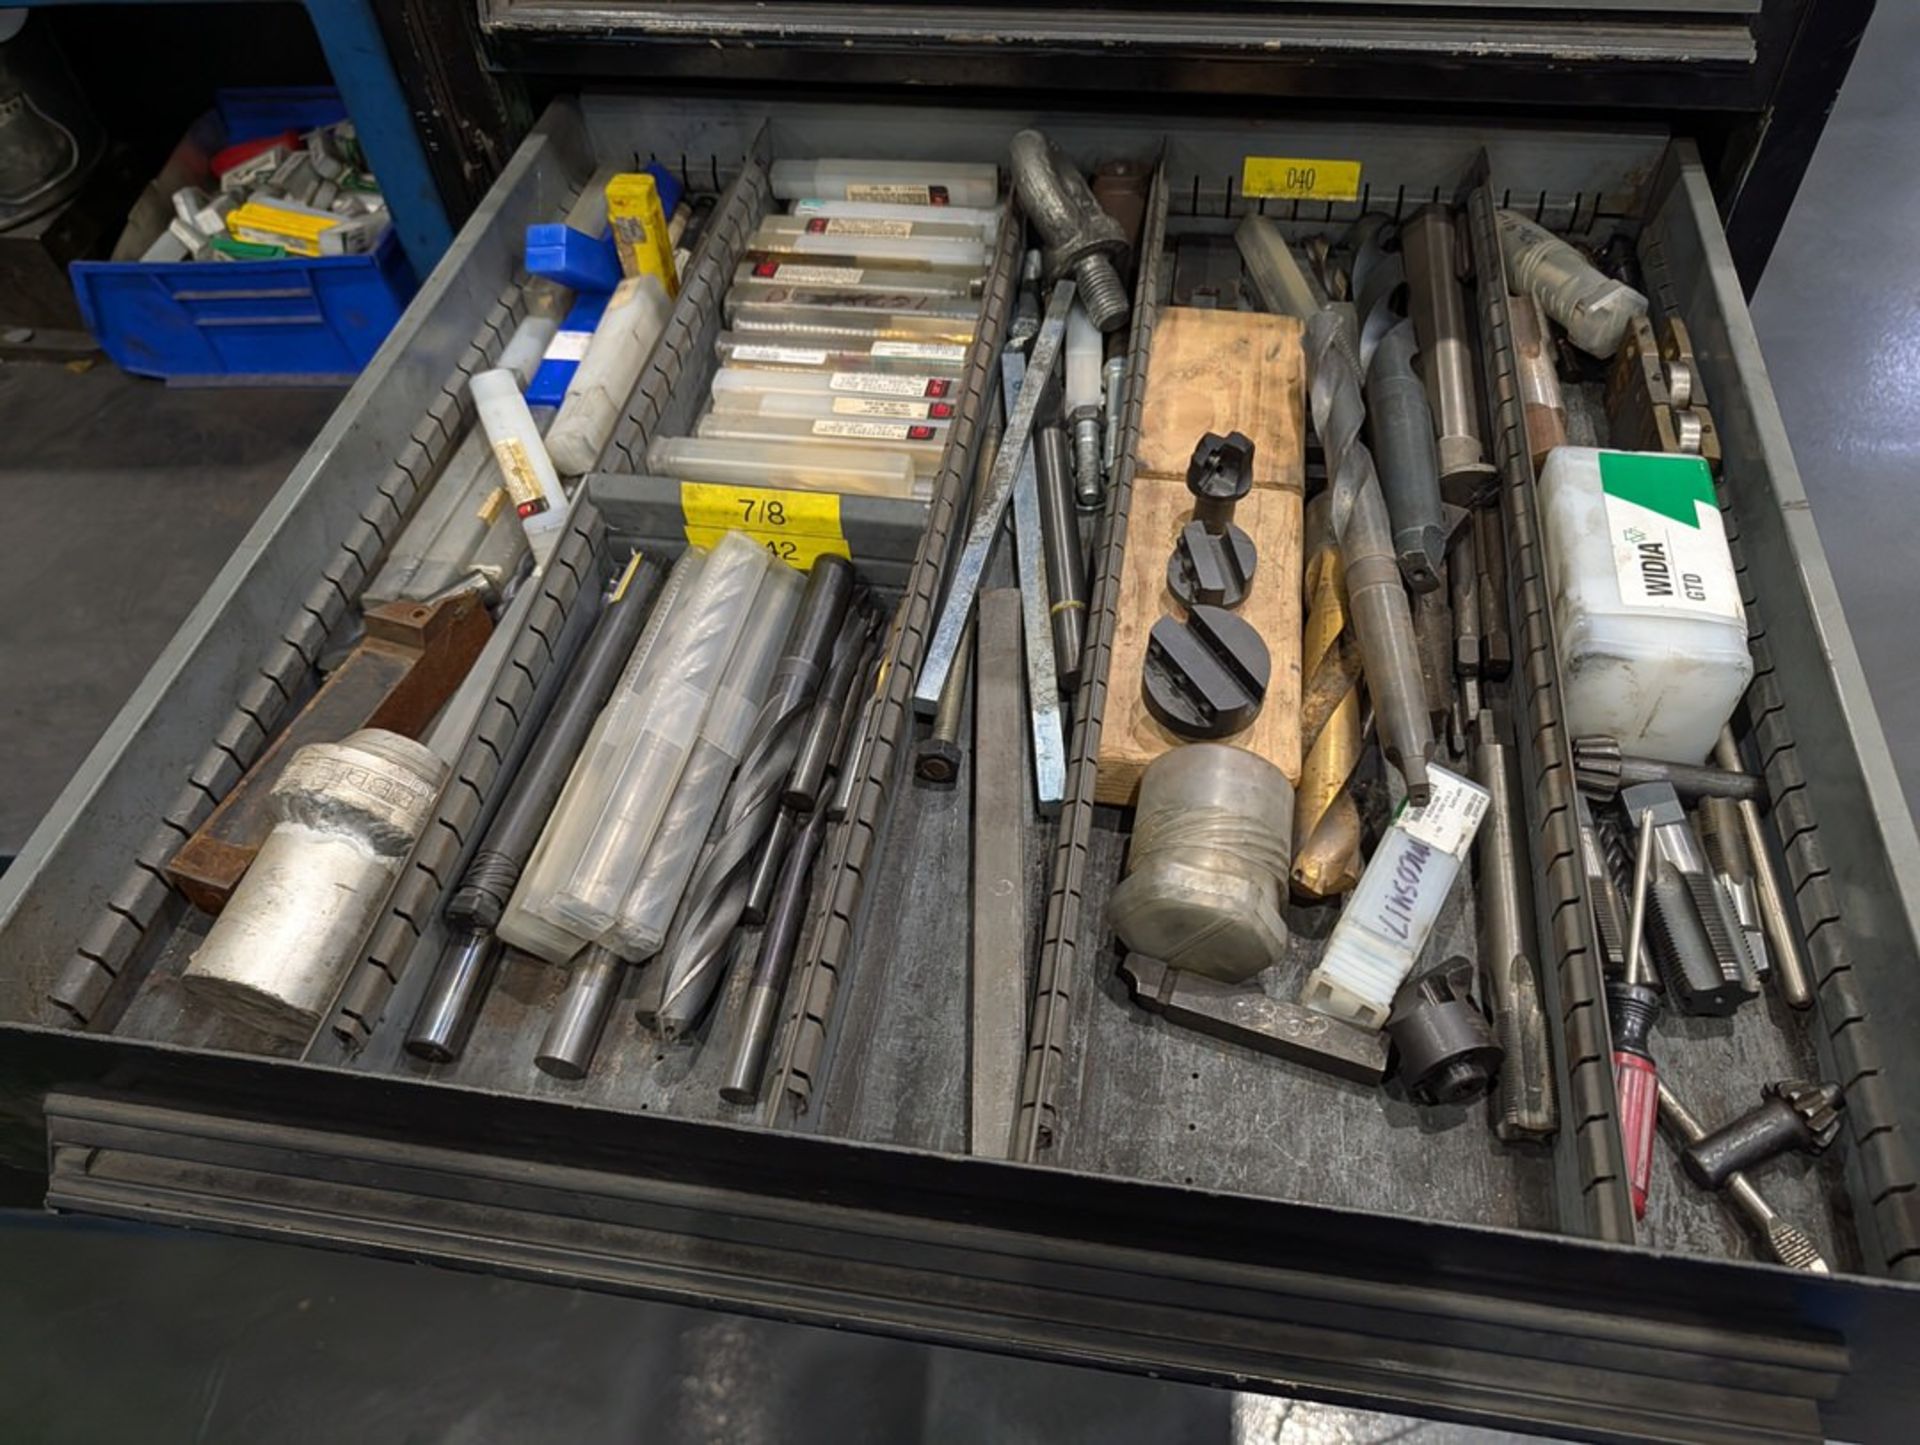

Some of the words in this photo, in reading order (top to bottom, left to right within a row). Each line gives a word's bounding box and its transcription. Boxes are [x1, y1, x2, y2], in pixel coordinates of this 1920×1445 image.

[1286, 167, 1316, 190] 040
[738, 498, 786, 526] 7/8
[1638, 542, 1673, 596] WIDIA
[1682, 573, 1706, 602] GTD
